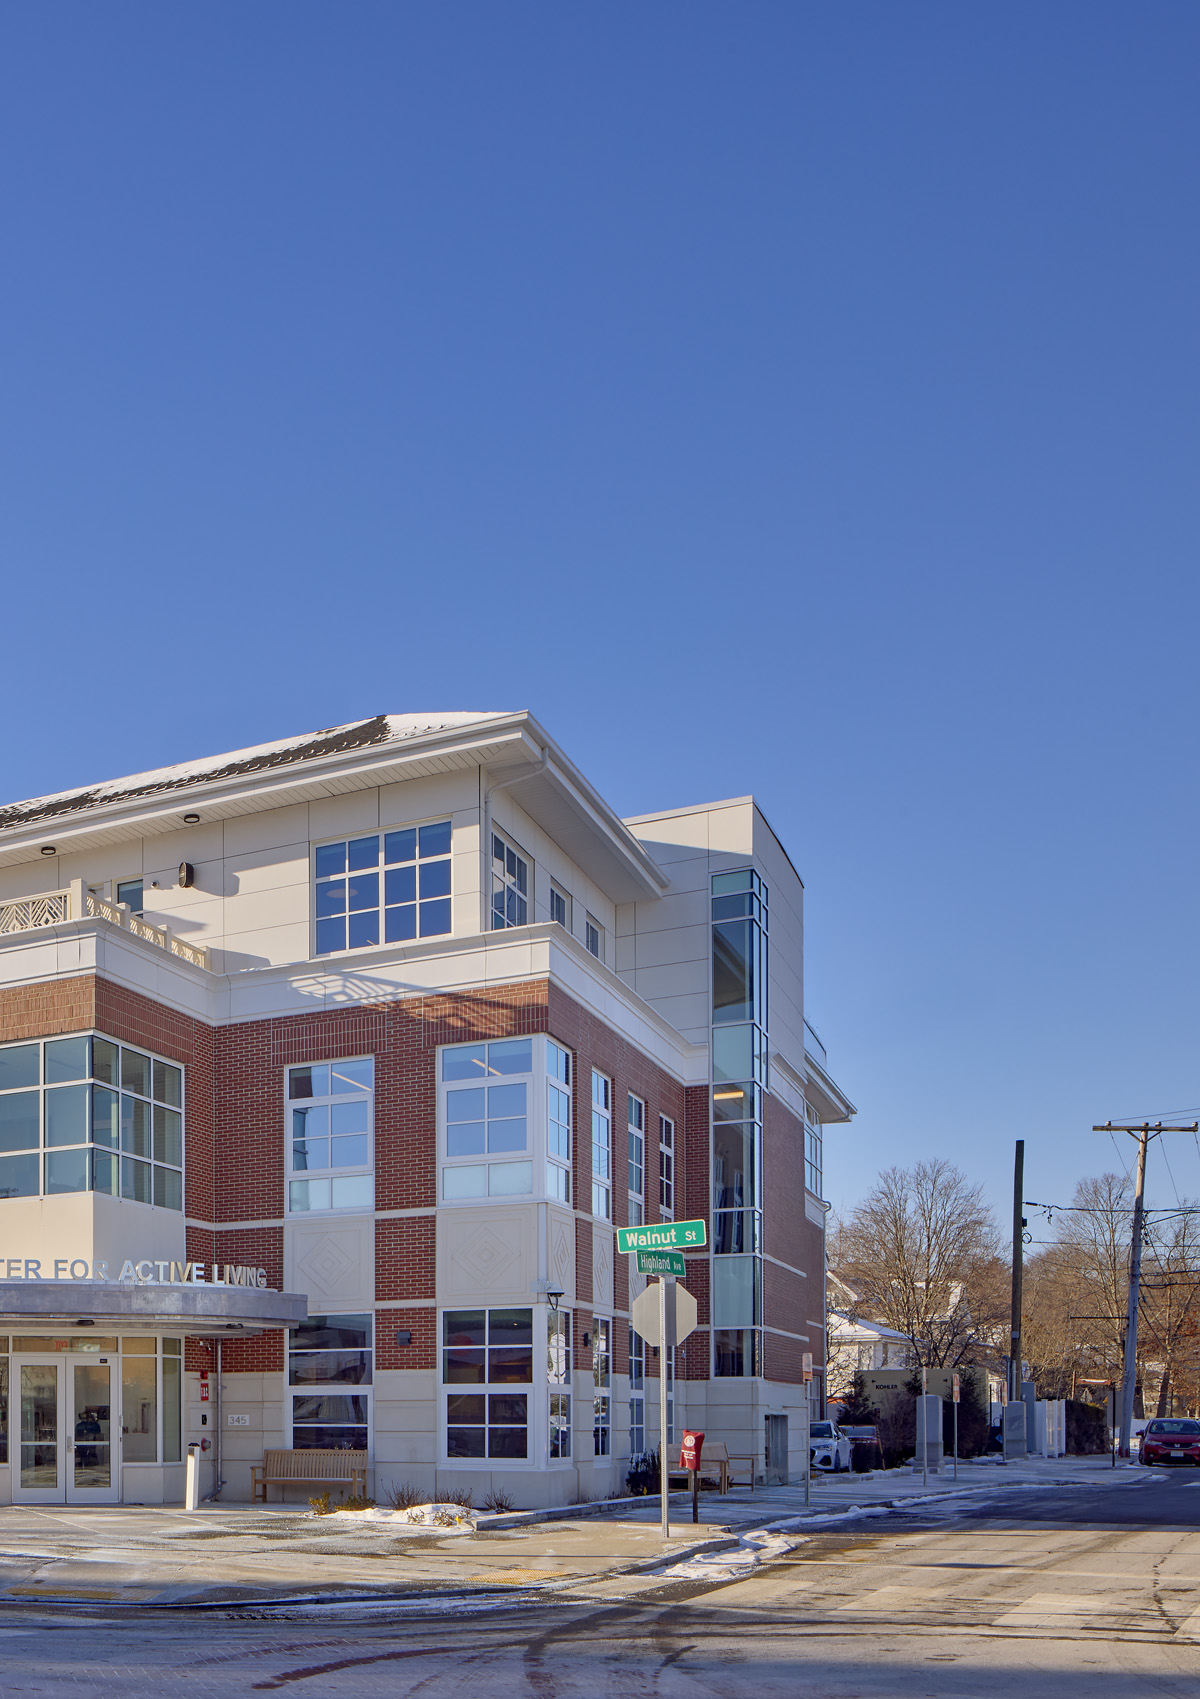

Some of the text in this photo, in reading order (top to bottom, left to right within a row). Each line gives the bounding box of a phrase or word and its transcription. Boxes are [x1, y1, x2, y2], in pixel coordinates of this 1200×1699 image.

[626, 1228, 696, 1247] Walnut St
[640, 1254, 682, 1272] Highland Ave
[54, 1259, 109, 1280] FOR
[118, 1259, 205, 1283] ACTIVE
[211, 1263, 268, 1288] LIVING
[229, 1415, 246, 1425] 345
